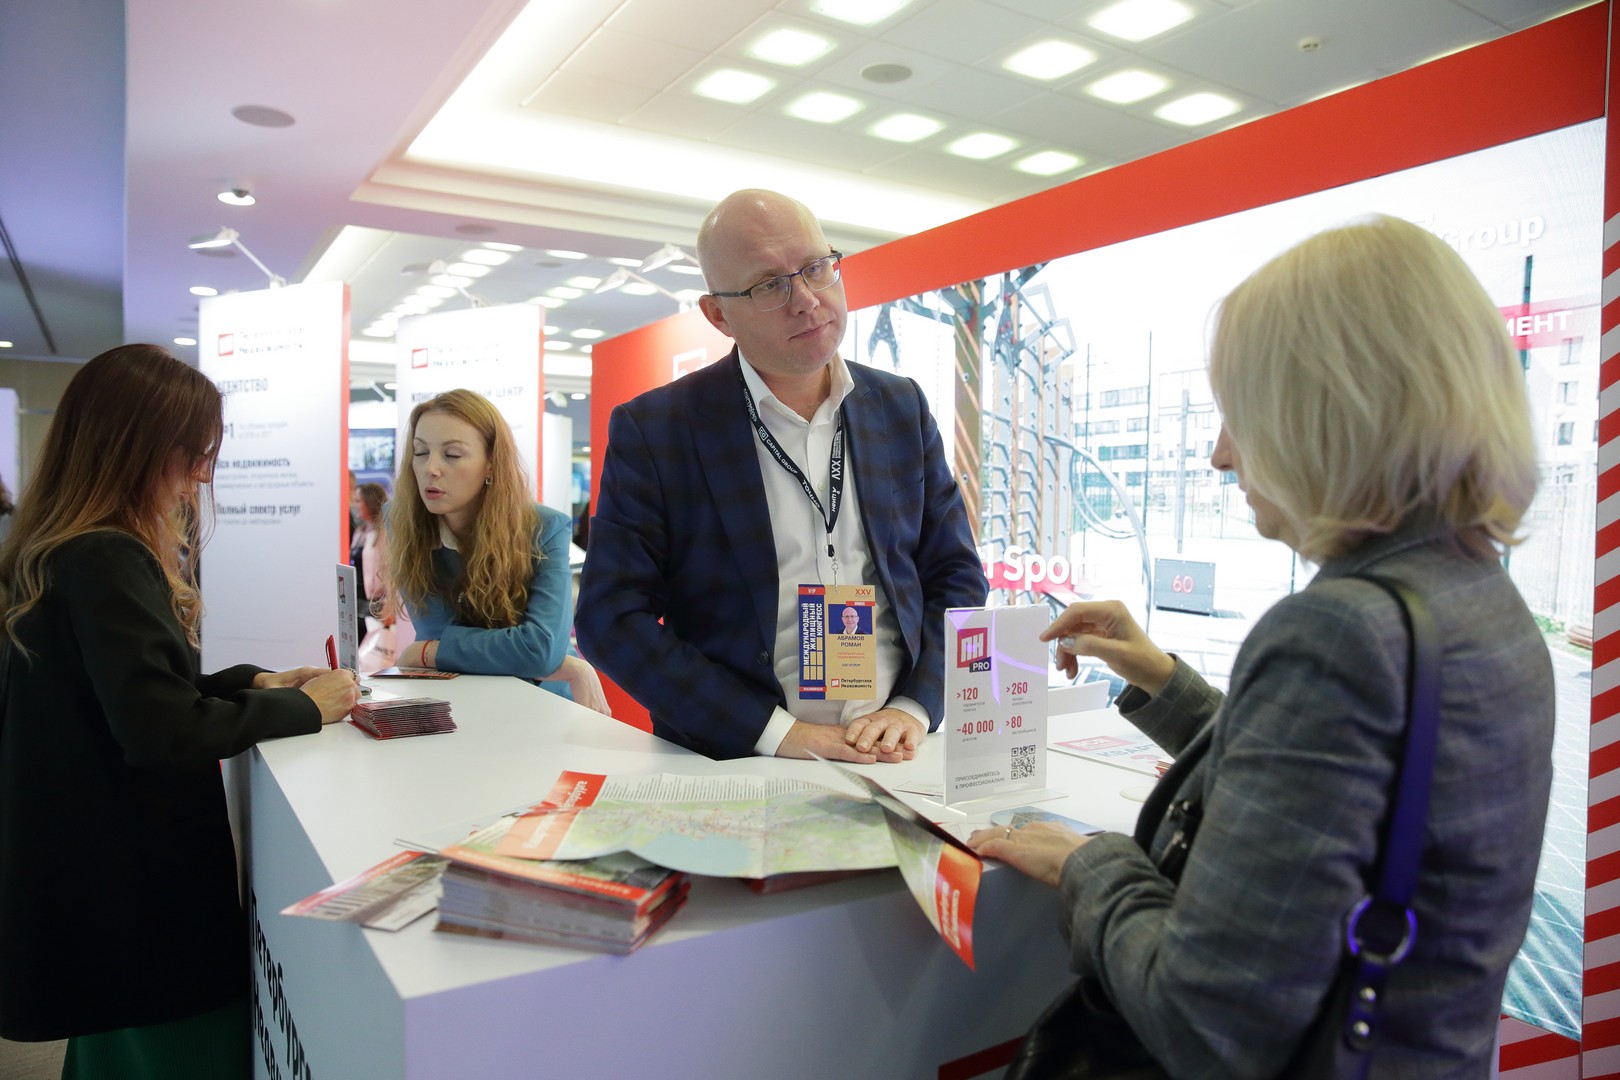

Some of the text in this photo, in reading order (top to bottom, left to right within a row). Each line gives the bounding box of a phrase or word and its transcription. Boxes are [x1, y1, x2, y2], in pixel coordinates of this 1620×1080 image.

[766, 439, 782, 459] CAPITAL
[831, 460, 841, 480] XXV
[1172, 574, 1195, 594] 60
[802, 602, 810, 666] МЕЖДУНАРОДНЫЙ
[809, 602, 817, 651] ЖИЛИЩНЫЙ
[972, 661, 990, 671] PRO
